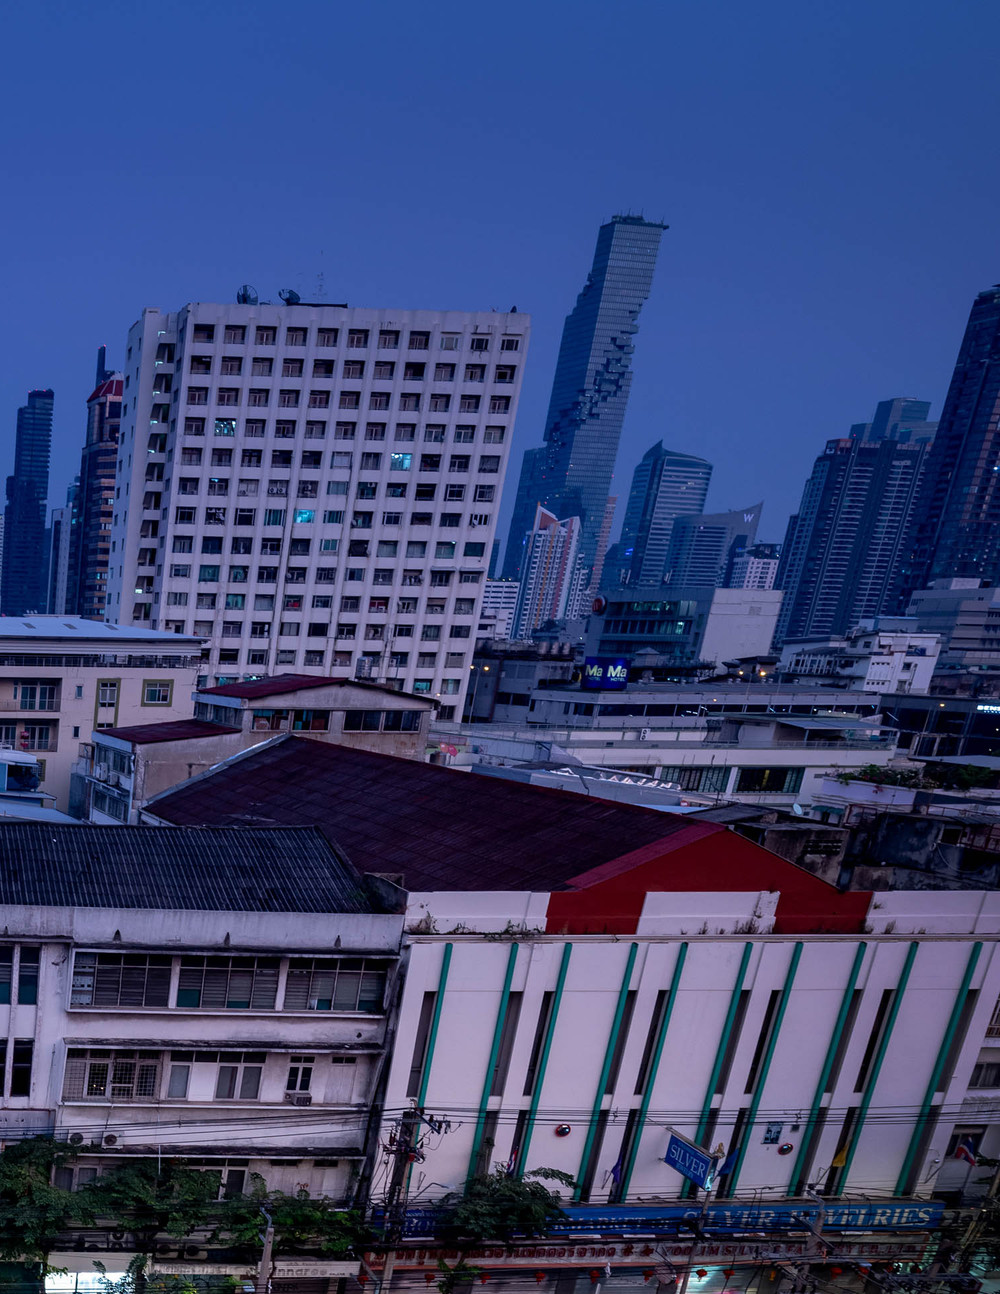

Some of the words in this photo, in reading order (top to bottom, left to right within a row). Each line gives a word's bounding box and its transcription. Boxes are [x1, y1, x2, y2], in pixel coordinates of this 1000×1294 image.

[585, 664, 603, 676] Ma
[607, 665, 627, 677] Ma
[669, 1144, 706, 1179] SILVER
[683, 1209, 777, 1231] SLVER
